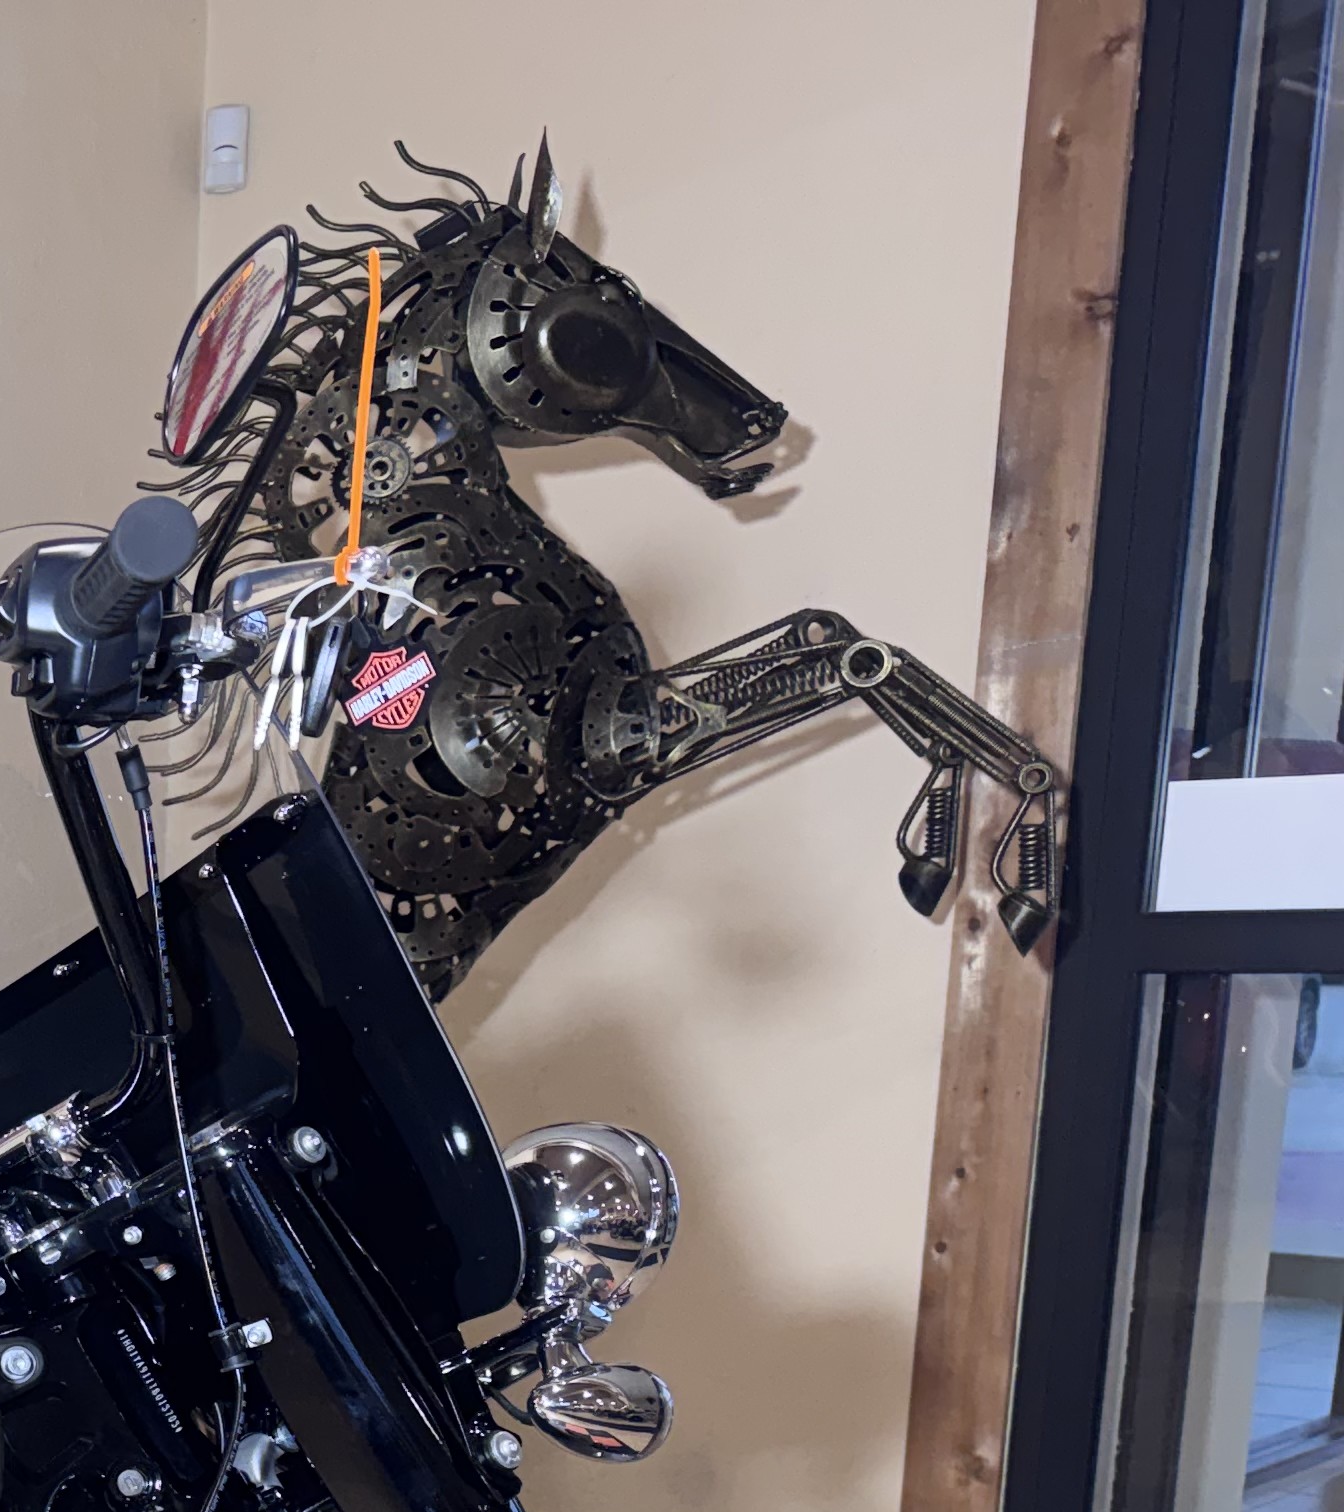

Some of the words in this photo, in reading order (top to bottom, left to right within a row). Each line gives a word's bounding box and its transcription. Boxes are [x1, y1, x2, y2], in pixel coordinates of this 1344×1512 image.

[350, 658, 431, 720] HARLEY-DAVIDSON
[359, 655, 403, 688] MOTOR
[377, 690, 419, 725] CYCLES
